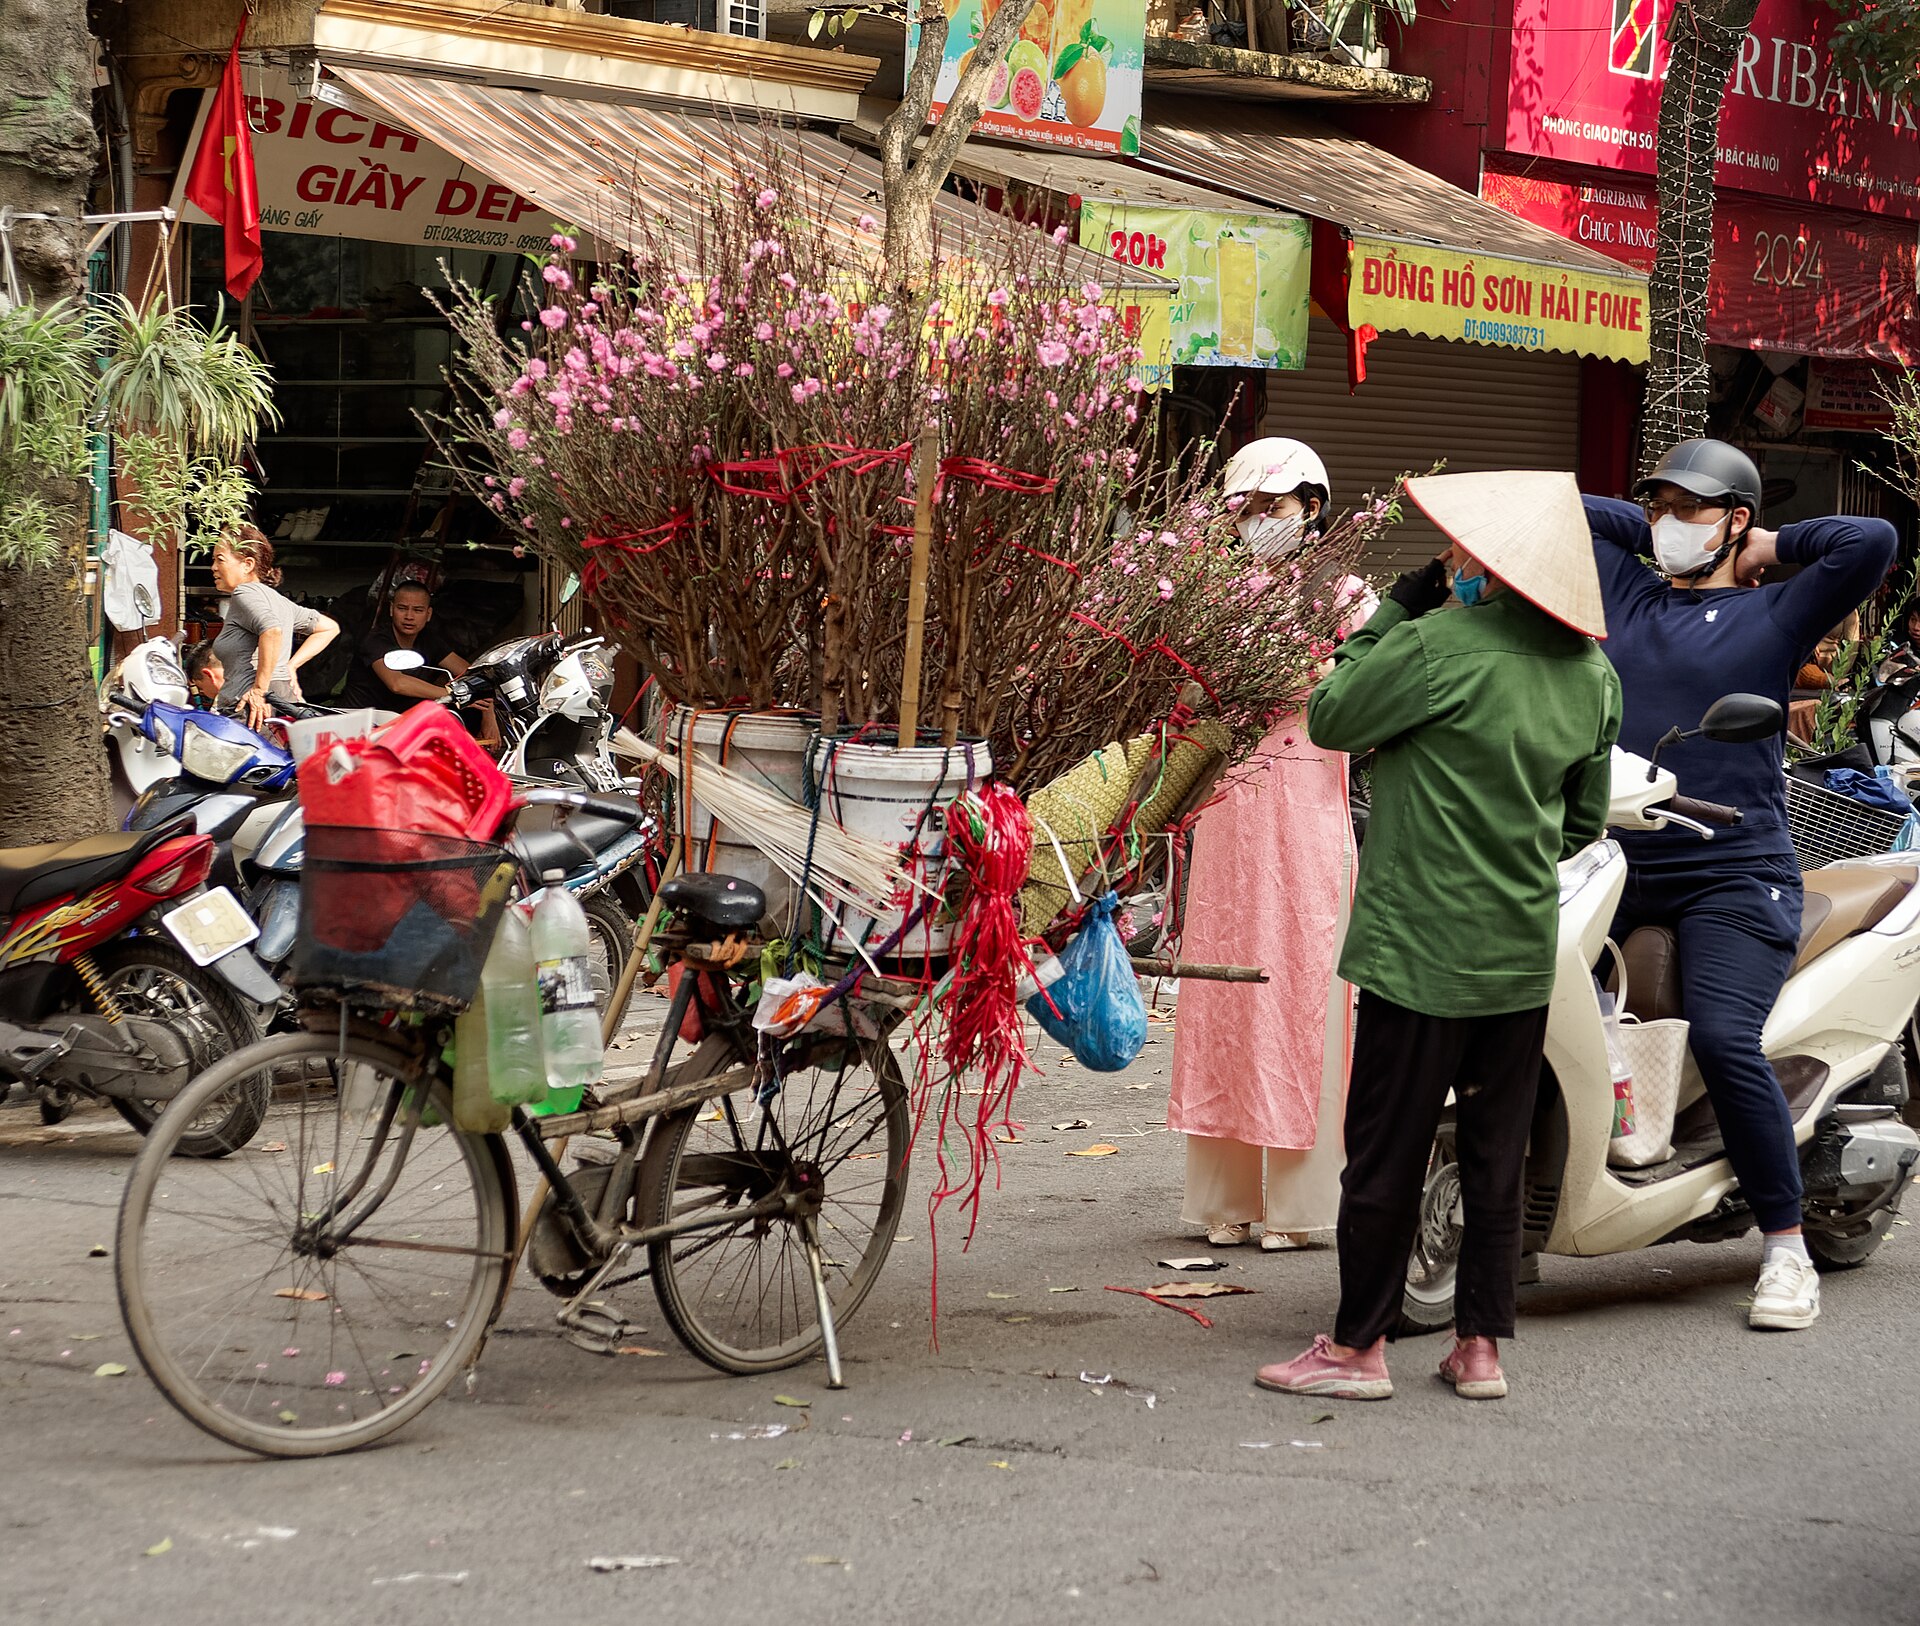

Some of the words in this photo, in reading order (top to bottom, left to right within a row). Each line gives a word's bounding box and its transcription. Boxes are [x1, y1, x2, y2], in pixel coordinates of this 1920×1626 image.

[1731, 31, 1918, 131] RIBANK
[1583, 122, 1610, 143] GIAO
[1611, 127, 1637, 149] DỊCH
[1746, 150, 1760, 169] HÀ
[1762, 153, 1779, 176] NỘI
[1591, 187, 1647, 211] AGRIBANK
[1753, 231, 1823, 290] 2024
[1362, 247, 1434, 304] ĐỒNG
[1442, 259, 1475, 309] HỒ
[1483, 275, 1532, 316] SƠN
[1540, 273, 1578, 322] HẢI
[1585, 290, 1643, 332] FONE
